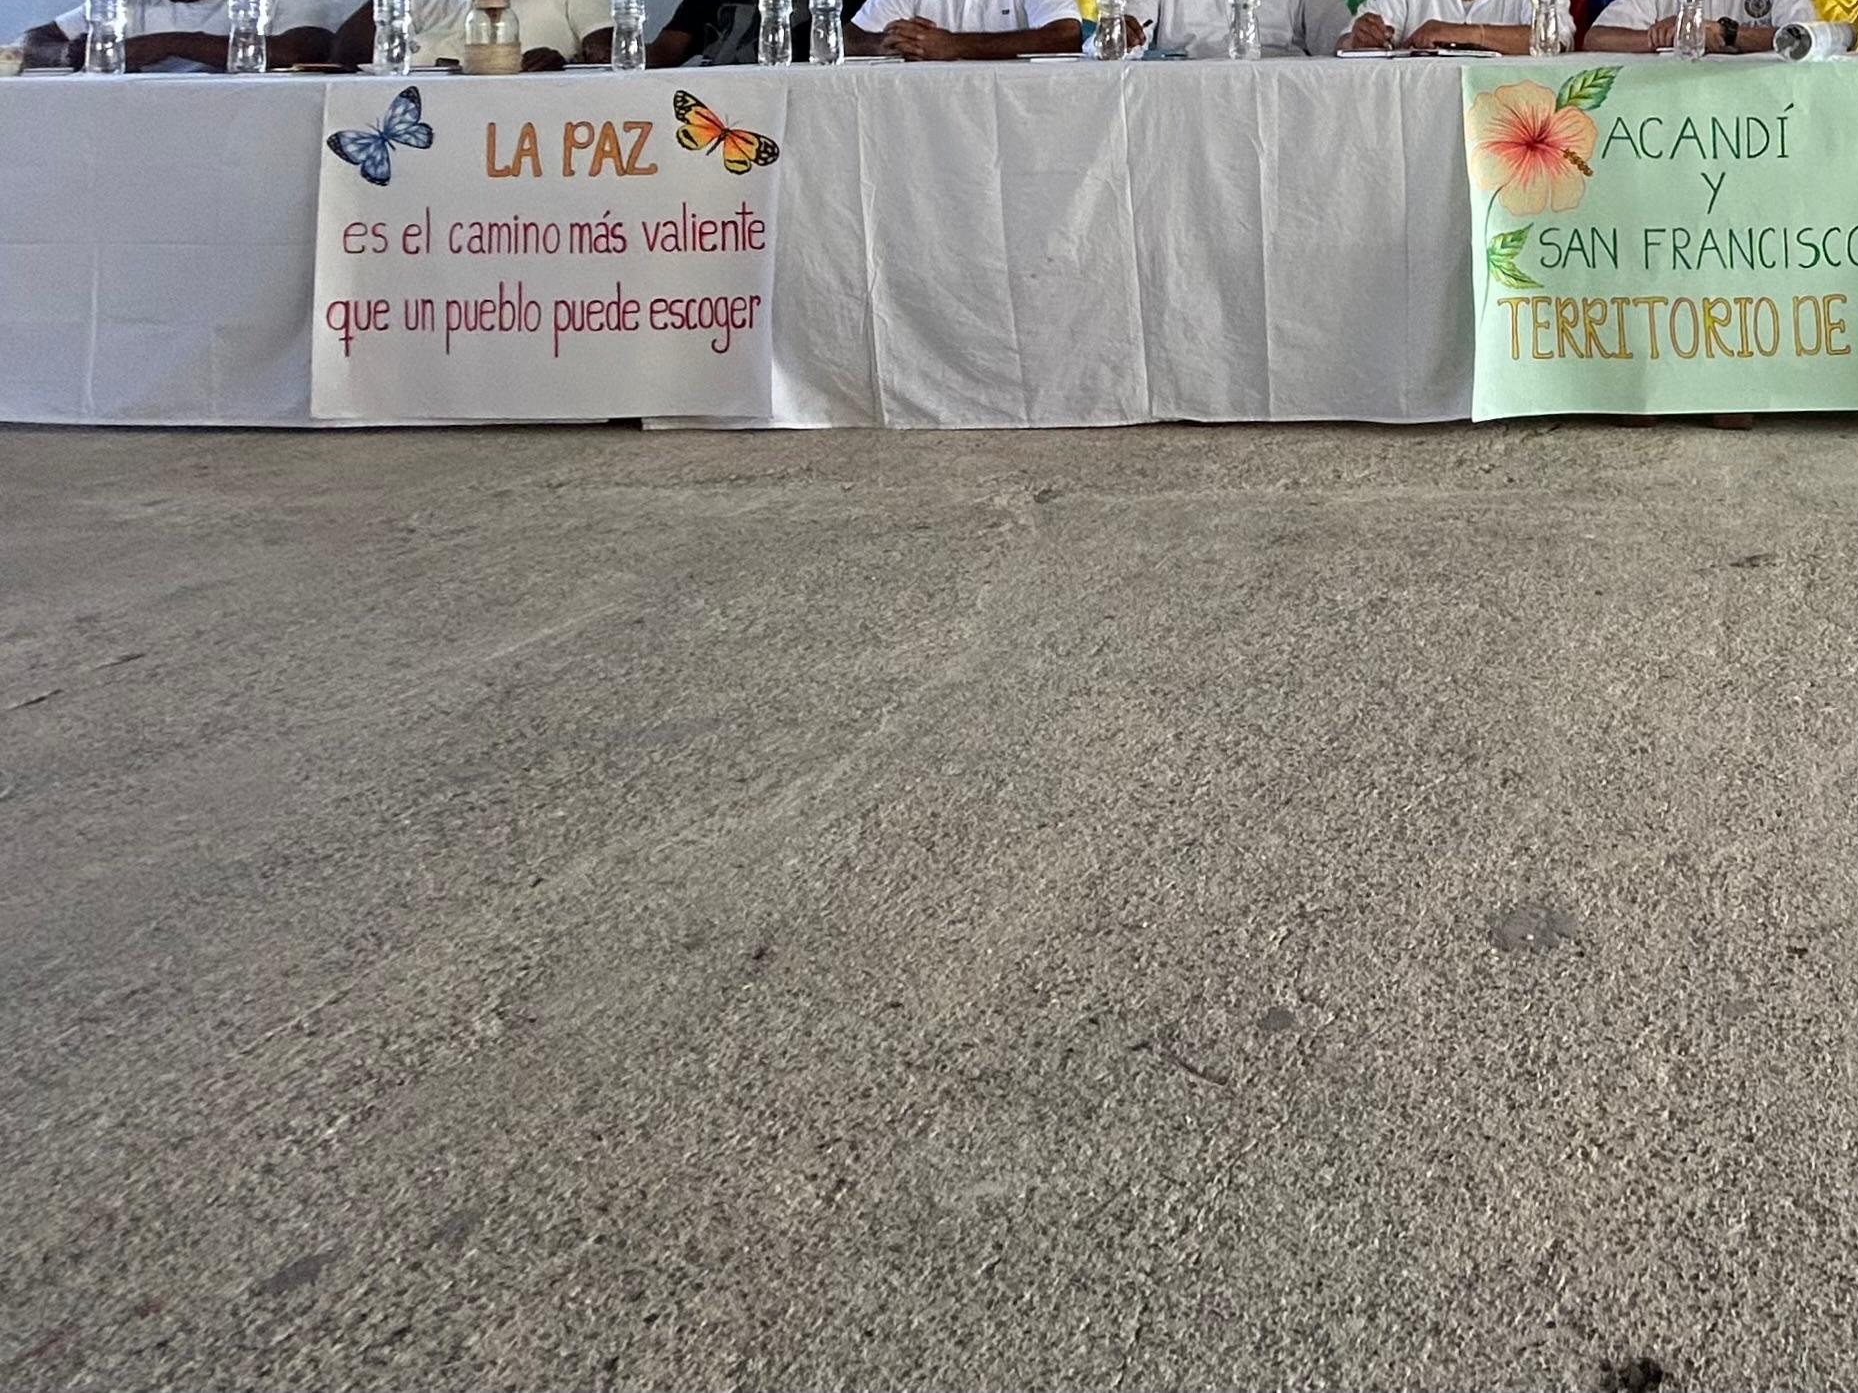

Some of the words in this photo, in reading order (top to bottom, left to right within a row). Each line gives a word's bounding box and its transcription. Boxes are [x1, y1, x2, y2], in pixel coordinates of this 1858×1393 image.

[485, 122, 543, 177] LA
[562, 121, 658, 177] PAZ
[1601, 103, 1795, 160] ACANDÍ
[343, 221, 388, 254] es
[402, 206, 431, 255] el
[449, 215, 560, 254] camino
[569, 210, 628, 255] más
[642, 201, 767, 253] valiente
[1539, 226, 1618, 270] SAN
[326, 298, 390, 358] que
[404, 298, 435, 331] un
[445, 281, 542, 355] pueblo
[553, 282, 640, 358] puede
[649, 293, 762, 354] escoger
[1497, 294, 1780, 360] TERRITORIO
[1793, 293, 1851, 357] DE
